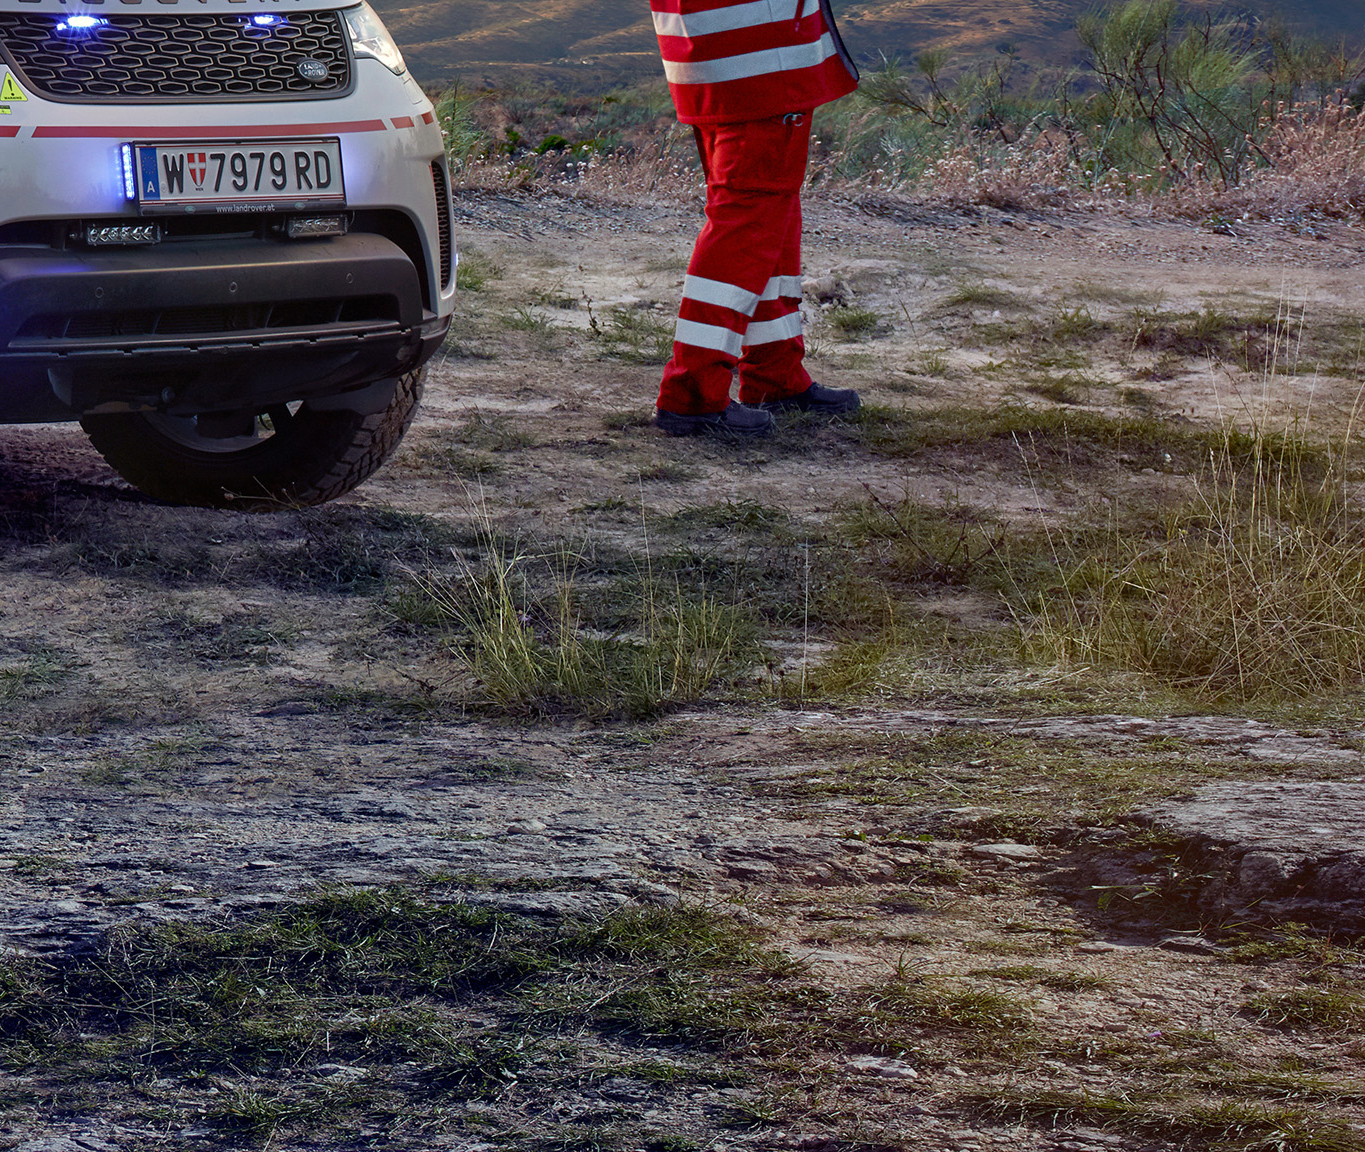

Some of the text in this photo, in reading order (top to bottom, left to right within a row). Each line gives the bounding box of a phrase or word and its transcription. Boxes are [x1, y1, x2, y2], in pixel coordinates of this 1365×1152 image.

[163, 150, 332, 194] W 7979 RD
[146, 181, 156, 194] A
[215, 203, 276, 214] www.landrover.at
